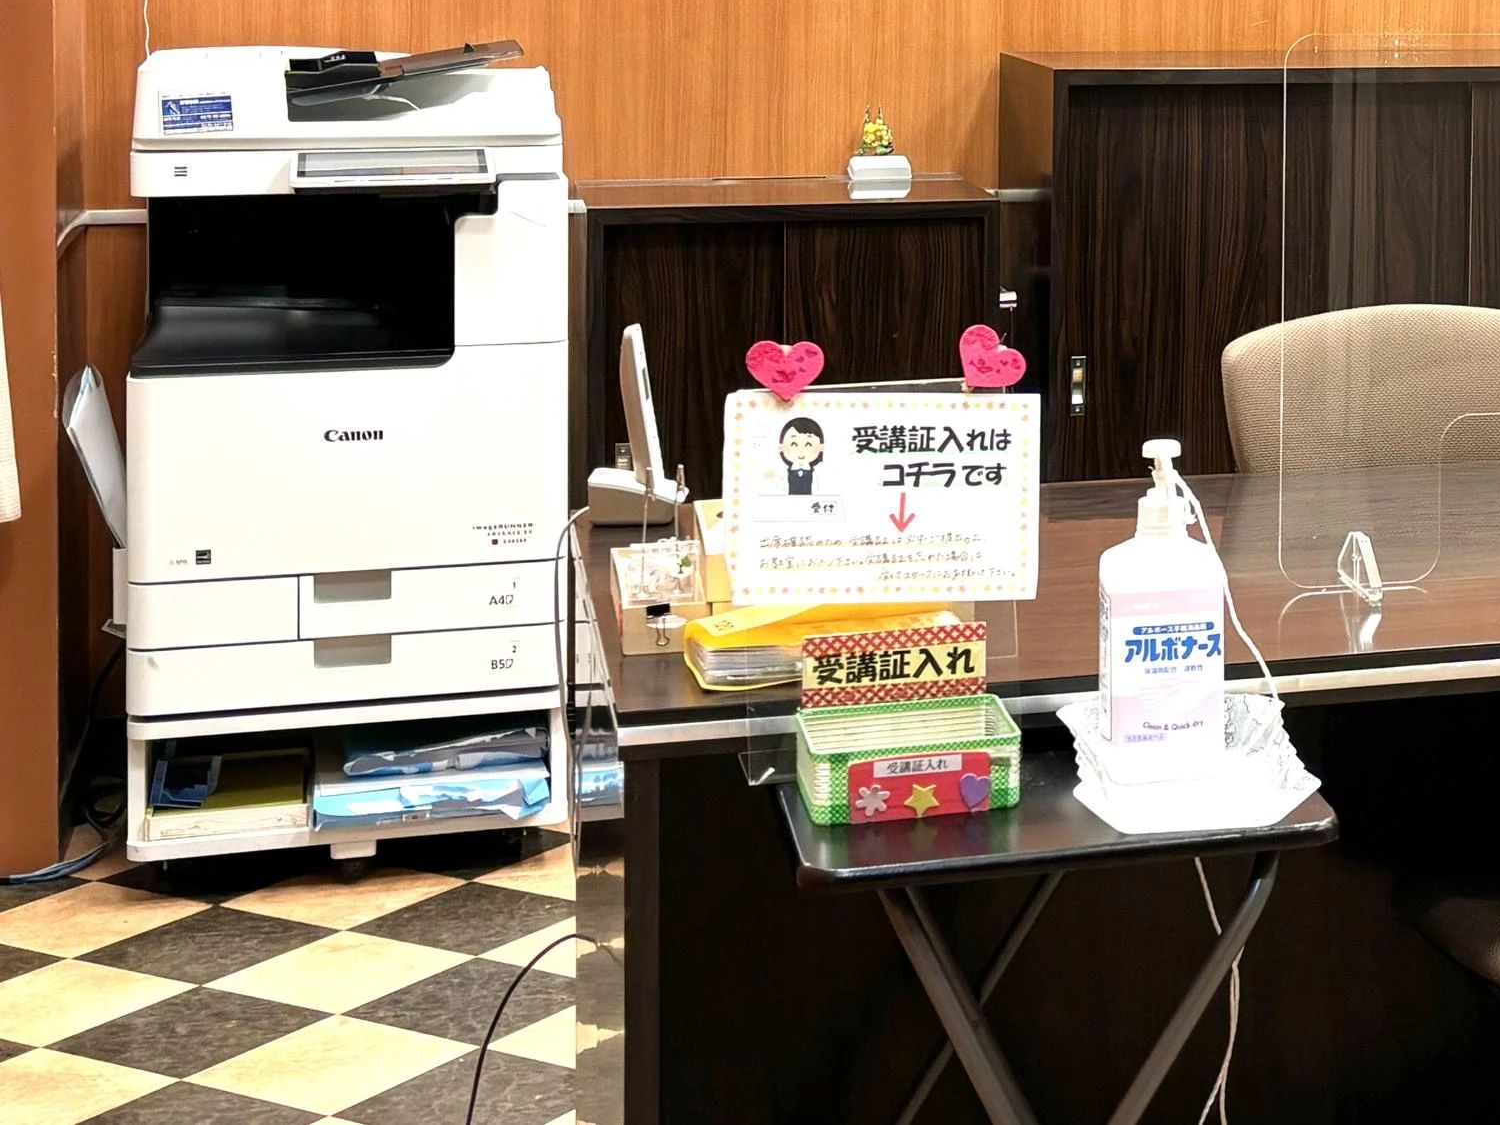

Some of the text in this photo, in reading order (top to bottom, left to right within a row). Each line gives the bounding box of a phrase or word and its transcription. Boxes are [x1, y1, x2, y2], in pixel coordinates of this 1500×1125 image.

[323, 429, 383, 442] Canon
[852, 425, 1012, 454] 受講証入れは
[882, 461, 1007, 487] コチラです
[811, 501, 835, 514] 受付
[1124, 634, 1222, 663] アルボナース
[812, 647, 975, 685] 受講証入れ
[887, 758, 949, 775] 受講証入れ
